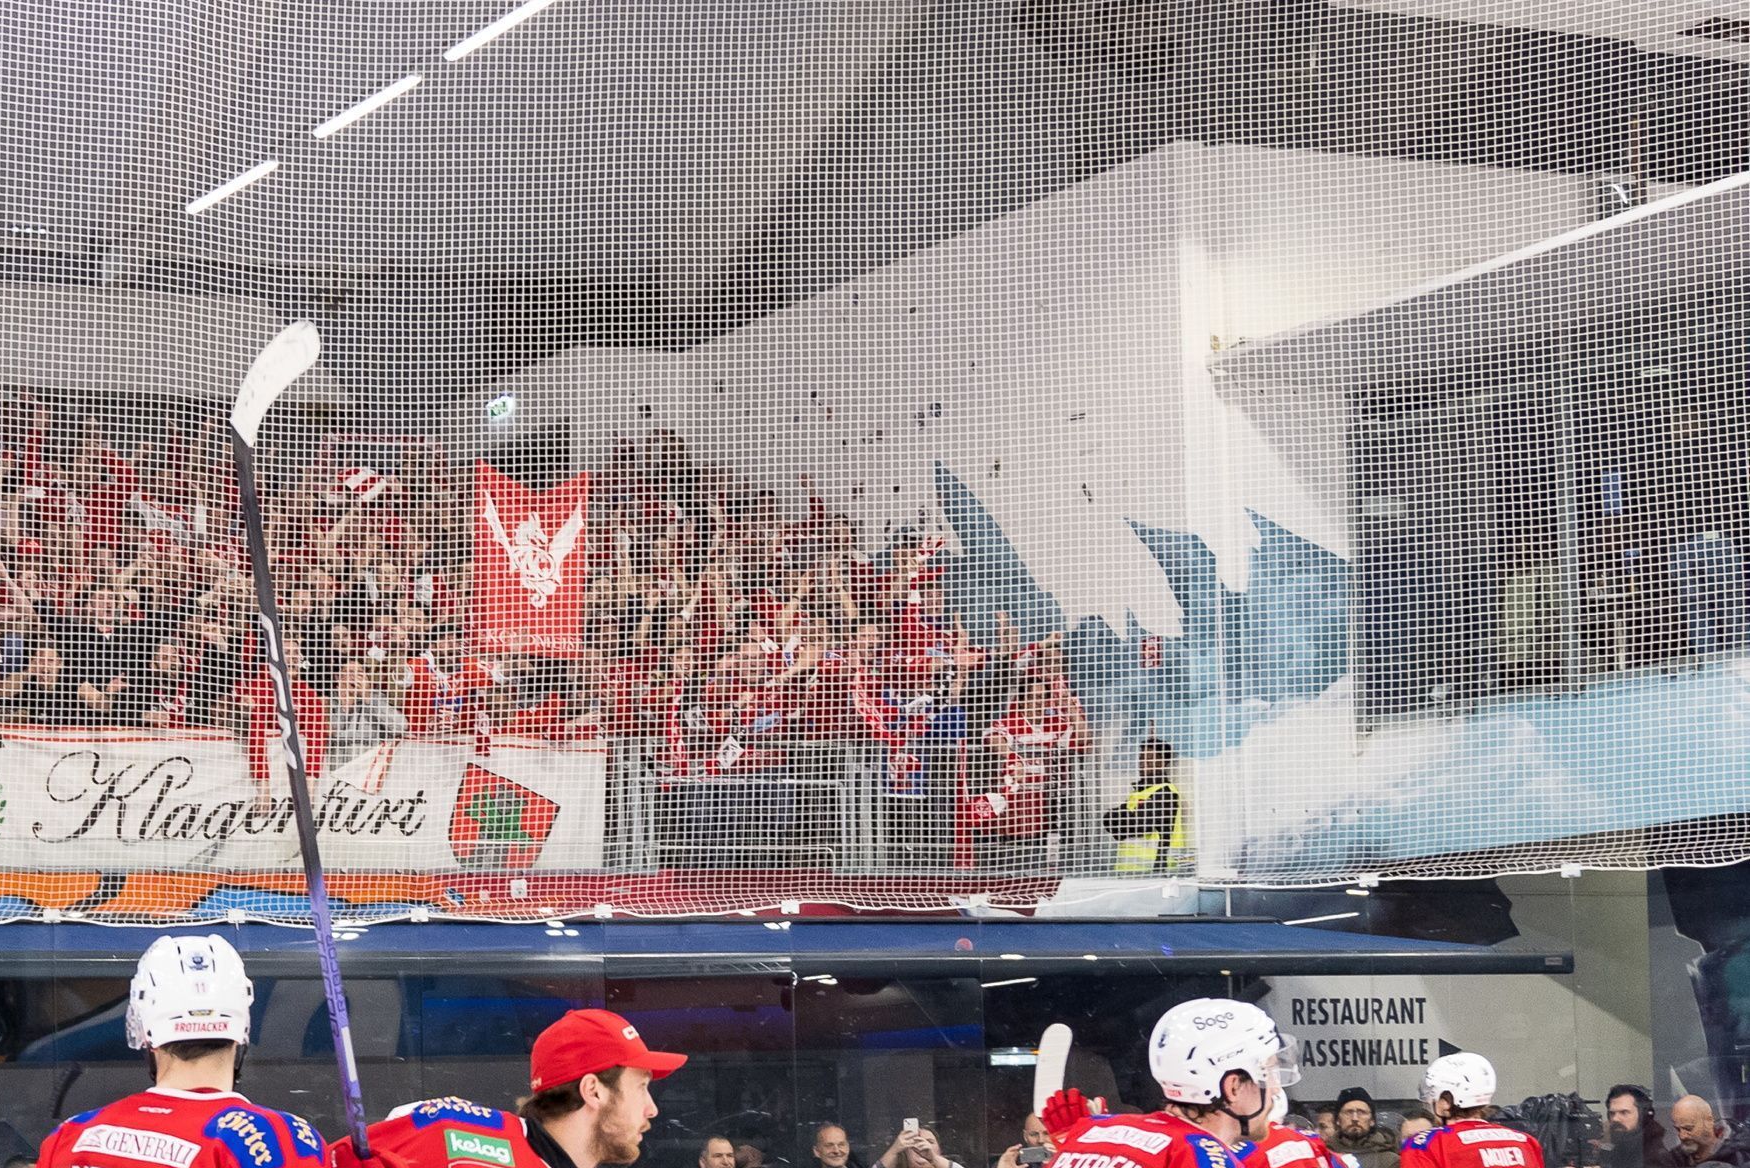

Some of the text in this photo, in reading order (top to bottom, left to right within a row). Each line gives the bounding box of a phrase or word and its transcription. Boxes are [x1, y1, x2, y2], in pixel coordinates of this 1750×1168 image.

[1291, 997, 1428, 1026] RESTAURANT
[1300, 1038, 1430, 1067] ASSENHALLE
[105, 1131, 196, 1166] GENERALI
[449, 1132, 512, 1163] kelag
